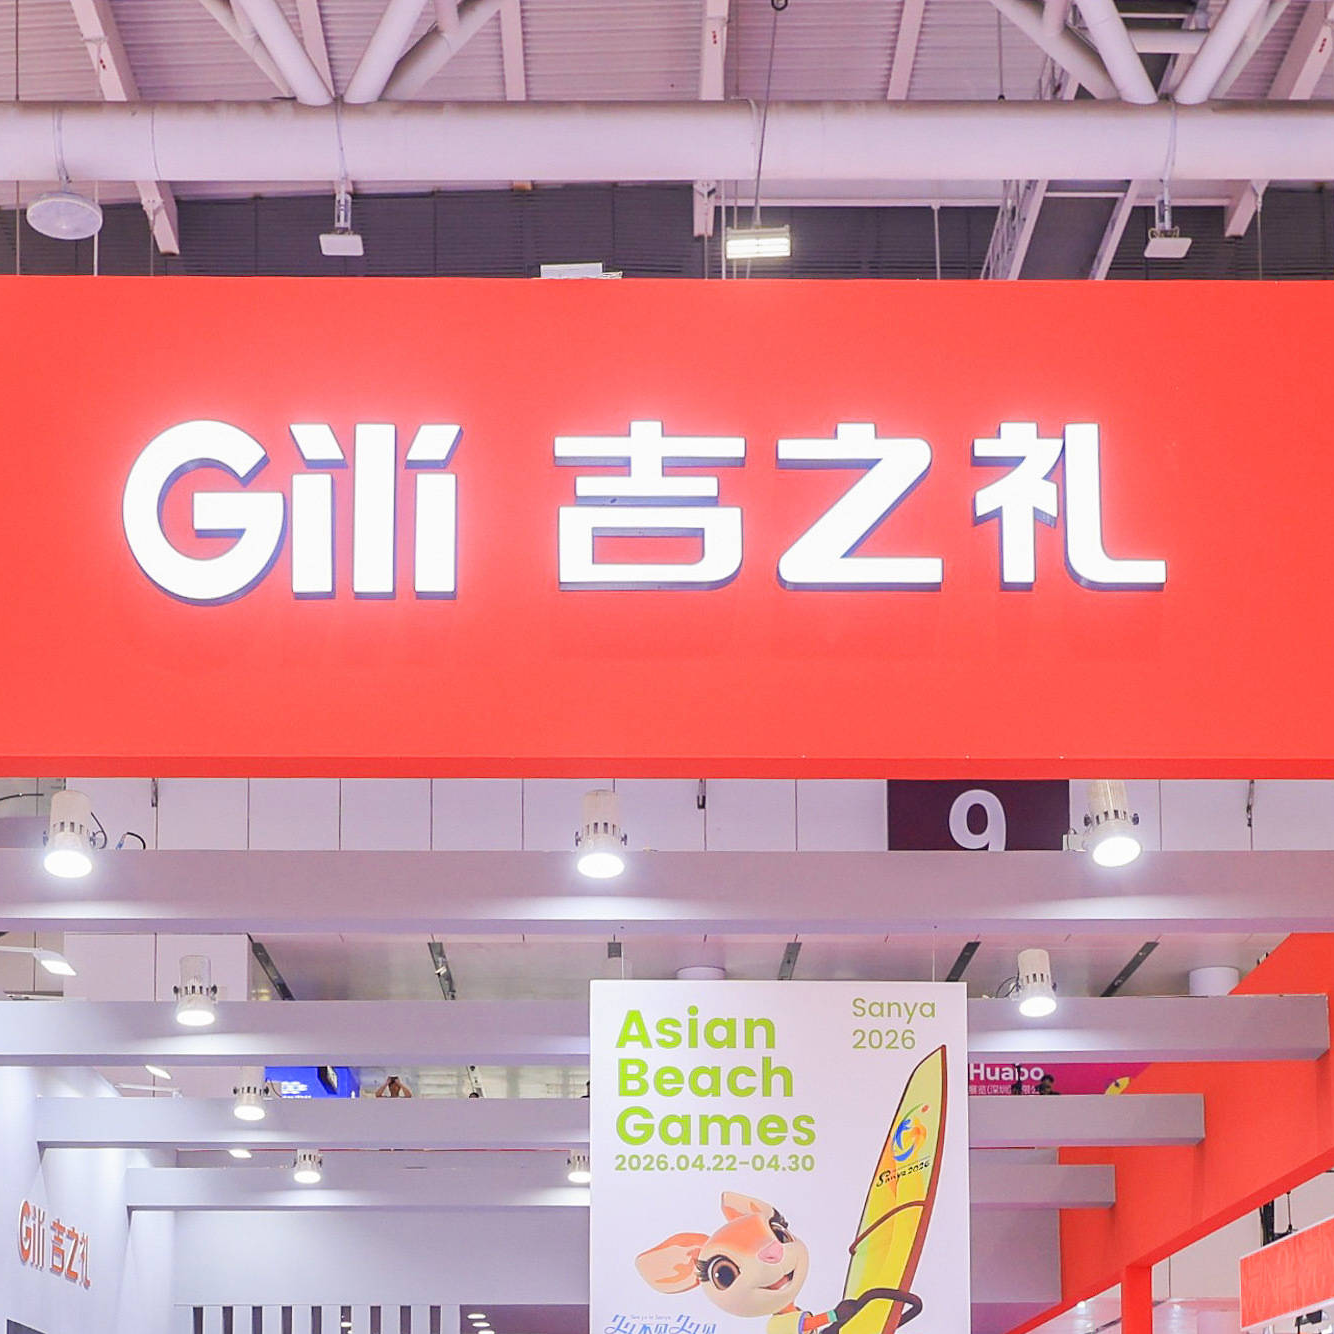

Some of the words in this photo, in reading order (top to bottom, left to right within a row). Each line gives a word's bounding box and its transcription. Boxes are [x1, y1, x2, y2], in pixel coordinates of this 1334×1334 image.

[123, 420, 462, 603] Gili
[553, 421, 1167, 592] 吉之礼
[948, 789, 1007, 851] 9
[616, 1006, 776, 1049] Asian
[852, 998, 936, 1025] Sanya
[852, 1029, 917, 1050] 2026
[617, 1057, 794, 1098] Beach
[615, 1105, 817, 1146] Games
[614, 1154, 816, 1173] 2026.04.22-04.30
[19, 1200, 46, 1271] Gili
[50, 1218, 91, 1289] 吉之礼
